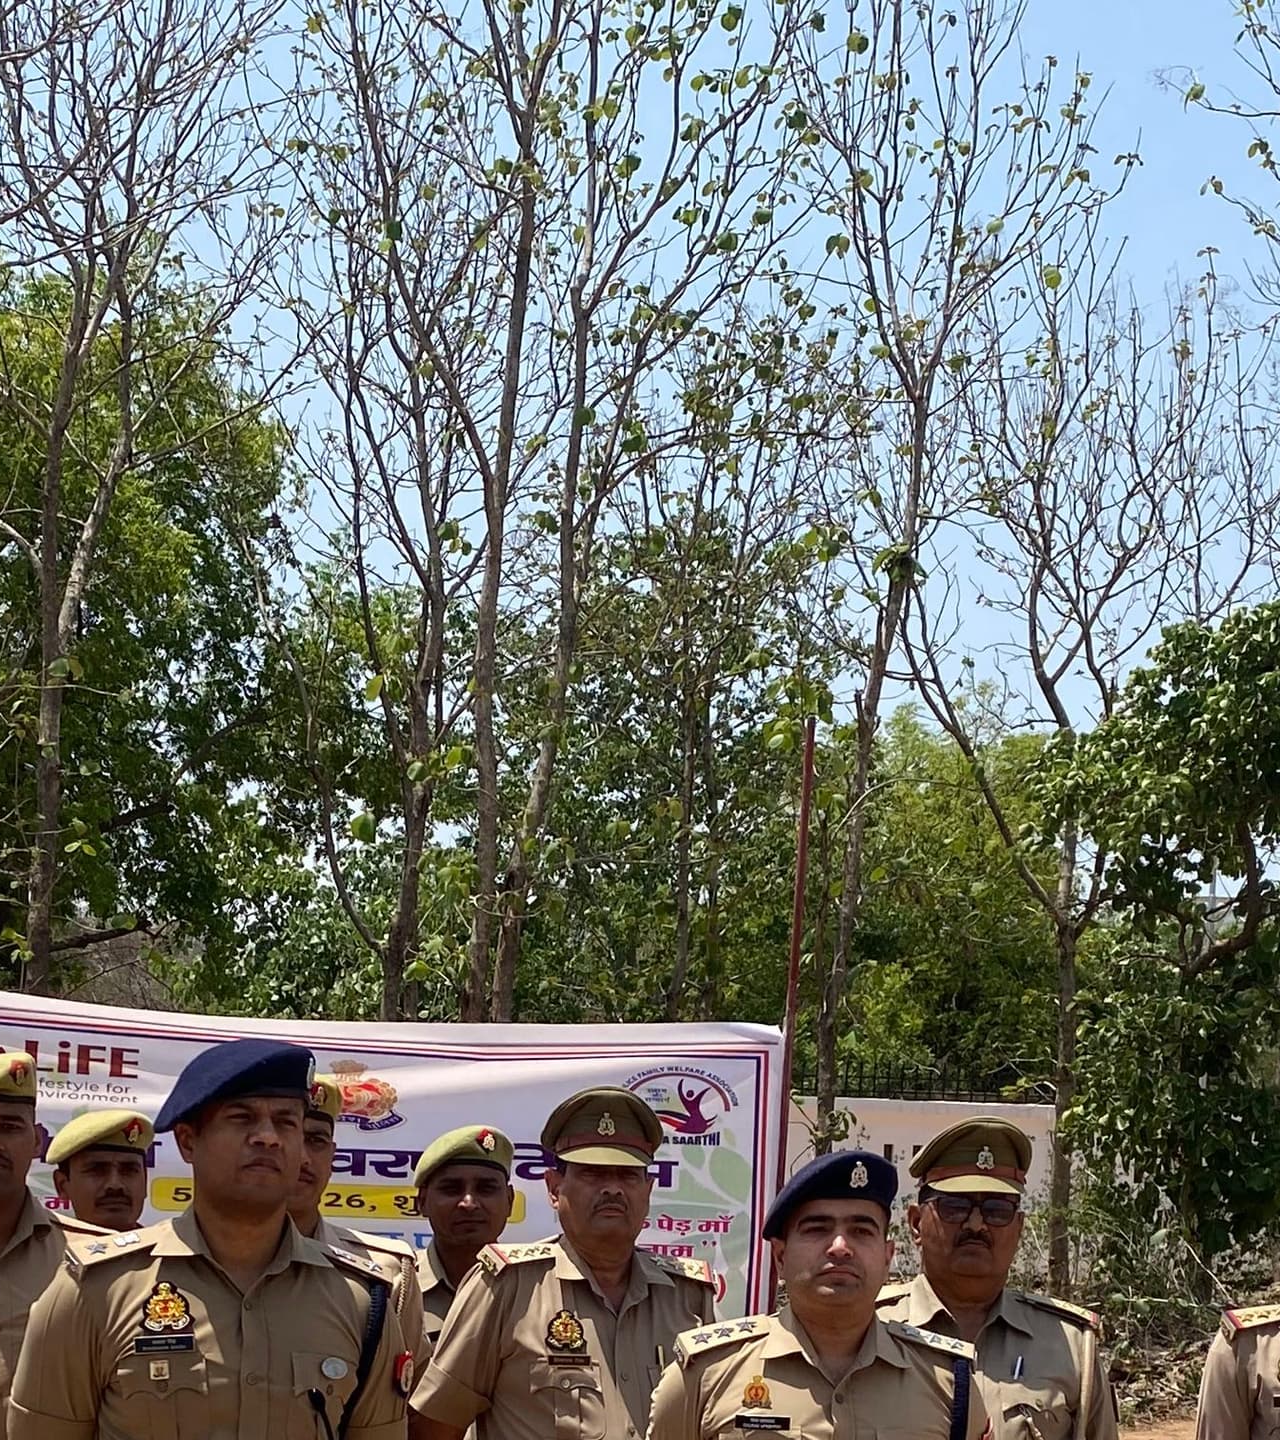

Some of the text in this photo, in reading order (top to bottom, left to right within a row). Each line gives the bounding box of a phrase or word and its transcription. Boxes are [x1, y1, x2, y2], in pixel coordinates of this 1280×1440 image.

[24, 1040, 140, 1079] LiFE
[667, 1066, 706, 1075] WELFARE
[38, 1077, 132, 1095] festyle for
[36, 1089, 138, 1104] nvironment
[672, 1132, 721, 1147] SAARTHI
[657, 1213, 692, 1236] पेड़
[697, 1215, 735, 1233] माँ
